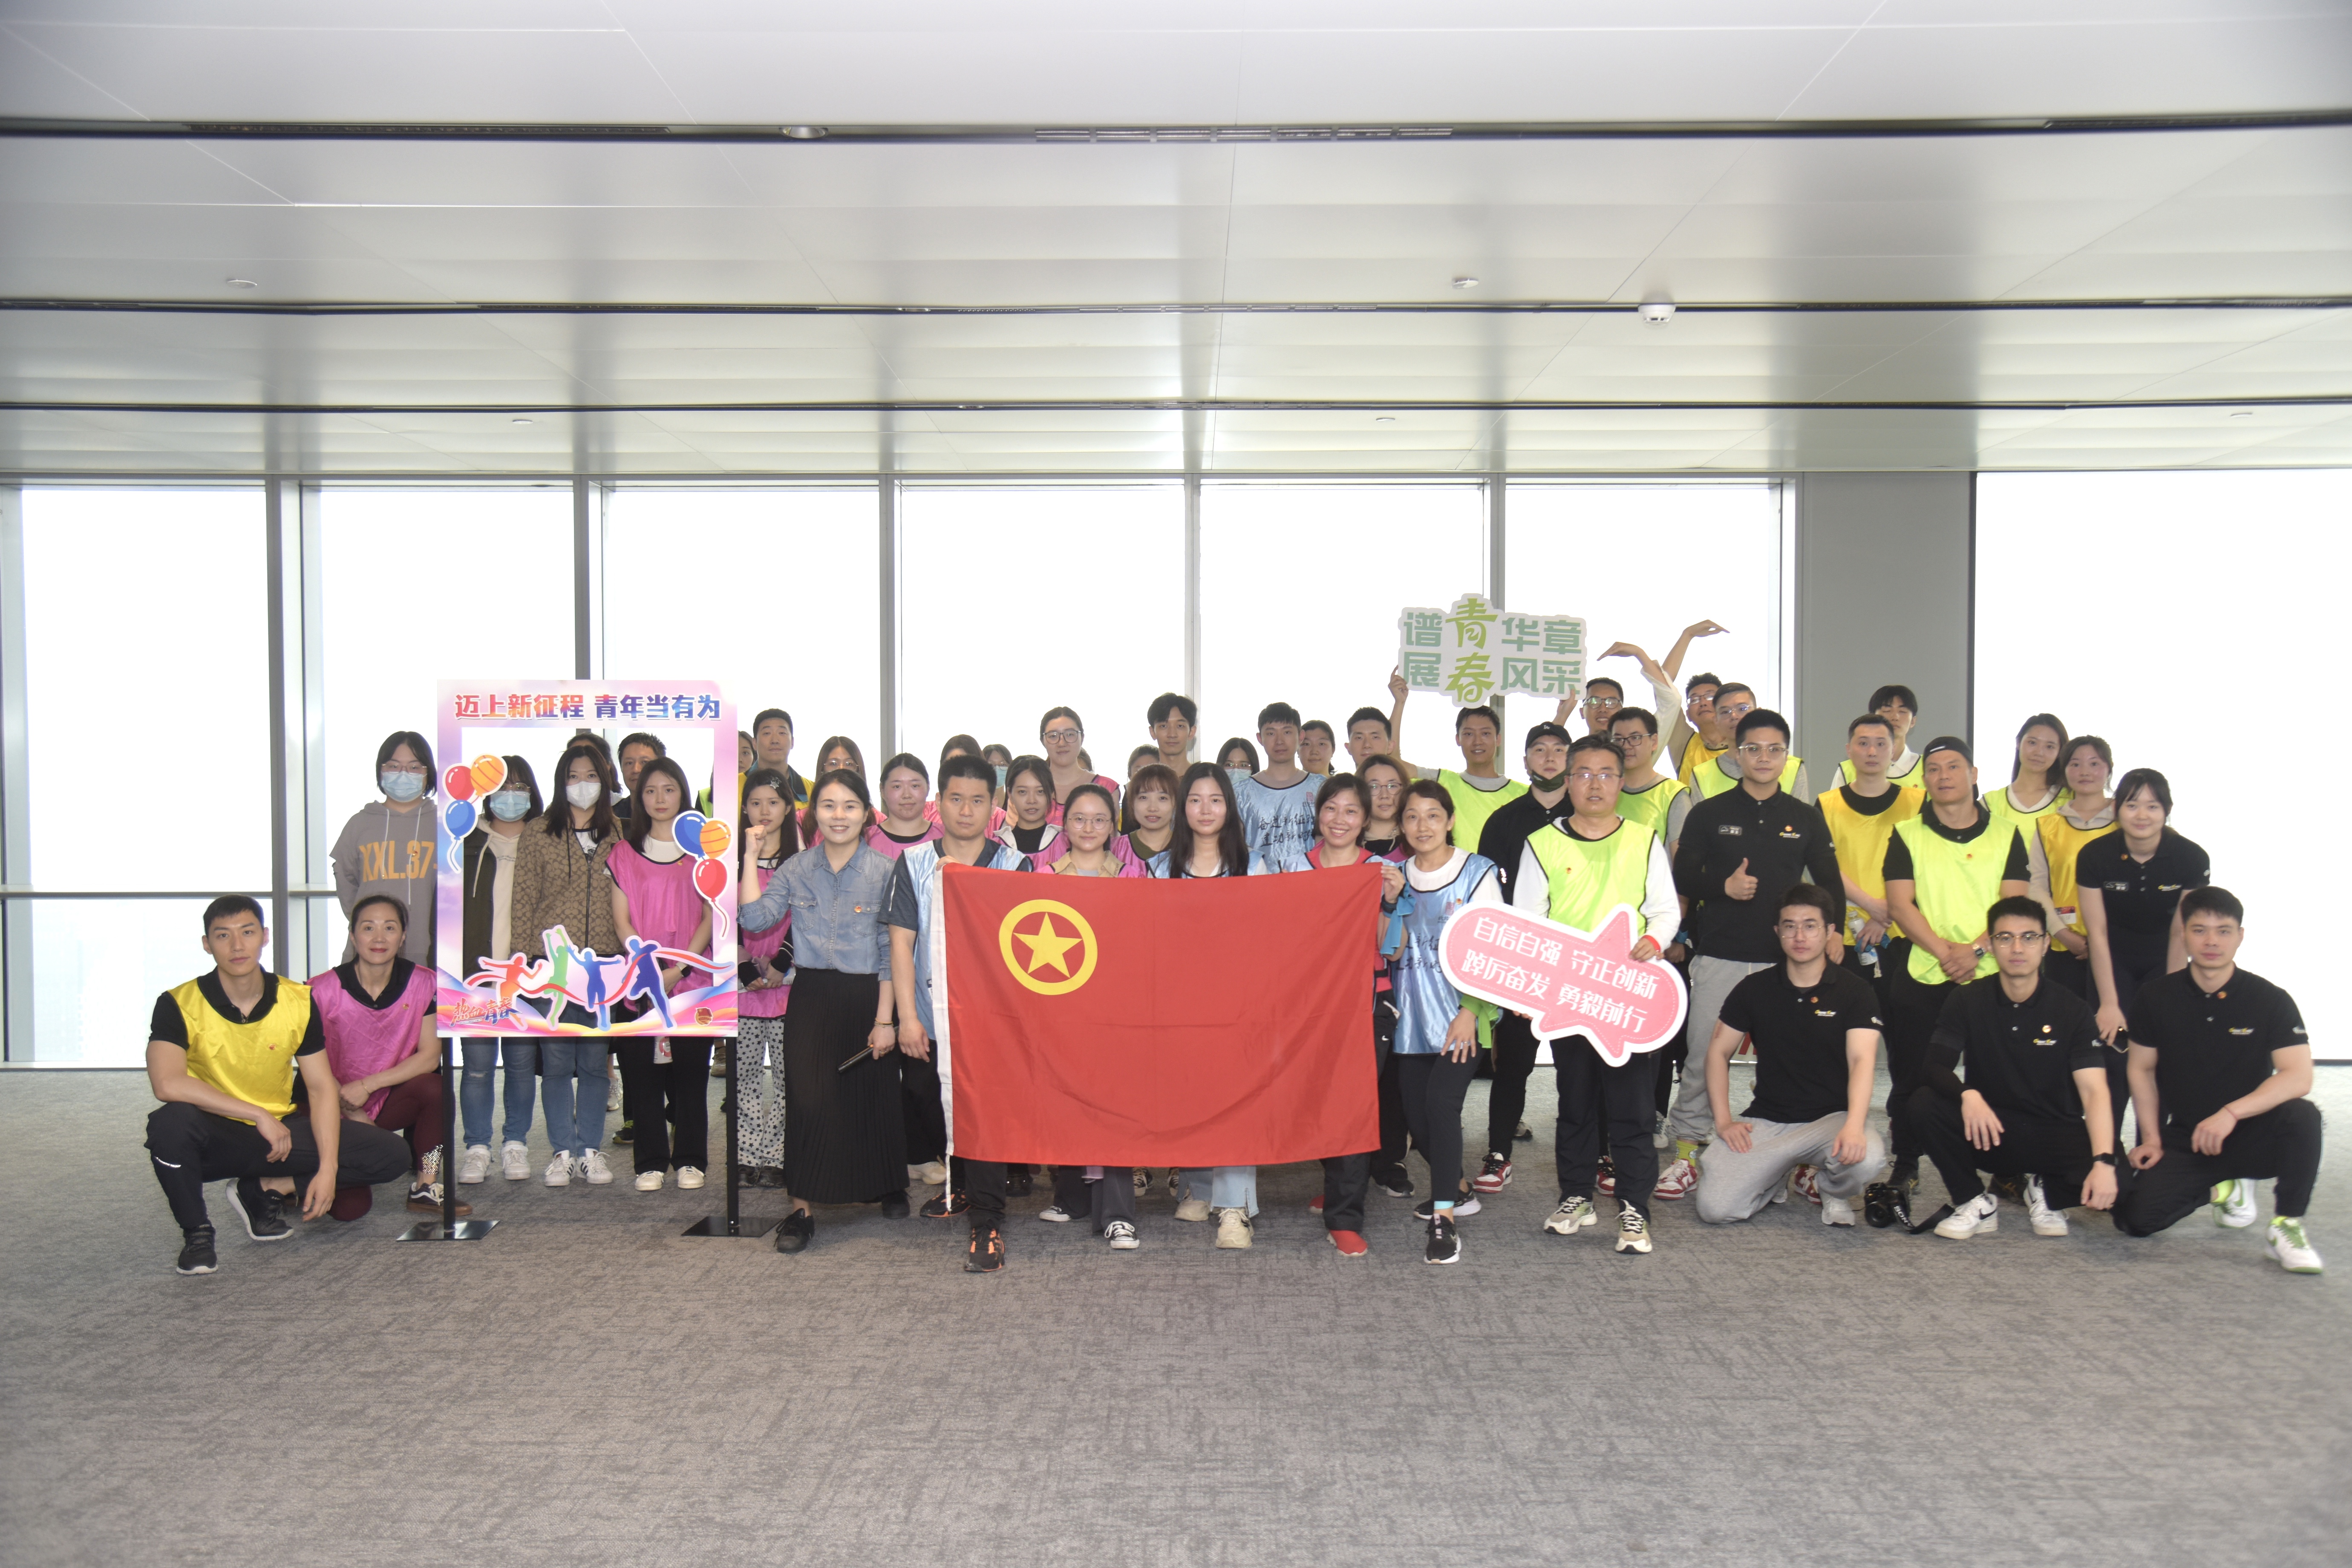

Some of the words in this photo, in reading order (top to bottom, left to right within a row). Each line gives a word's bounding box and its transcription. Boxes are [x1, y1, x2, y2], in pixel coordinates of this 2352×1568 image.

[455, 694, 585, 719] 迈上新征程
[594, 694, 721, 720] 青年当有为
[1473, 917, 1563, 966] 自信自强
[1571, 949, 1660, 1000] 守正创新
[1461, 949, 1551, 1000] 踔厉奋发
[1556, 983, 1648, 1032] 勇毅前行
[450, 997, 521, 1026] 热血青春
[1894, 1205, 1913, 1227] SONY
